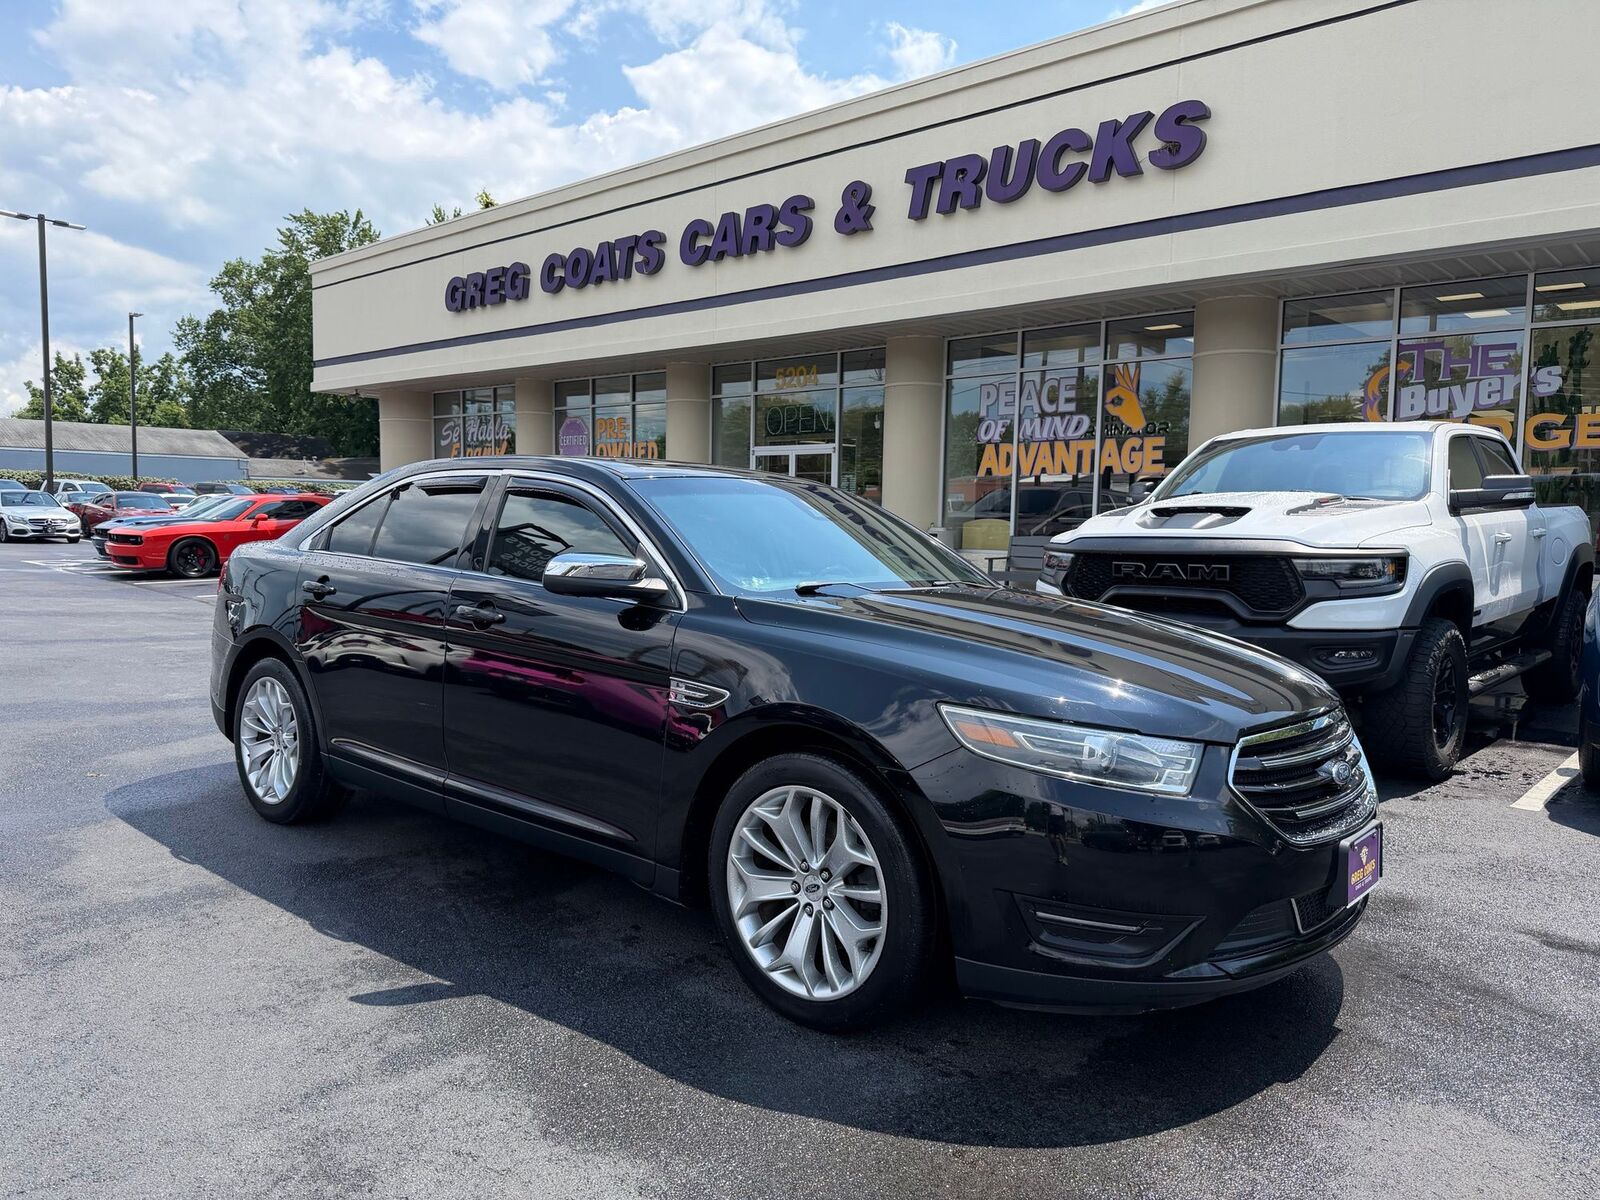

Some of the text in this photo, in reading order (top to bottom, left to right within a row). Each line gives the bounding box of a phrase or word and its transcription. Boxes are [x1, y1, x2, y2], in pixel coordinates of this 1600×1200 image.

[445, 99, 1212, 312] GREG COATS CARS & TRUCKS
[775, 364, 818, 389] 5204
[1397, 340, 1518, 383] THE
[978, 376, 1080, 418] PEACE
[440, 416, 512, 447] Se Habla
[766, 403, 830, 436] OPEN
[977, 413, 1092, 444] OF MIND
[560, 434, 588, 447] CERTIFIED
[977, 435, 1167, 479] ADVANTAGE
[1111, 561, 1230, 582] RAM
